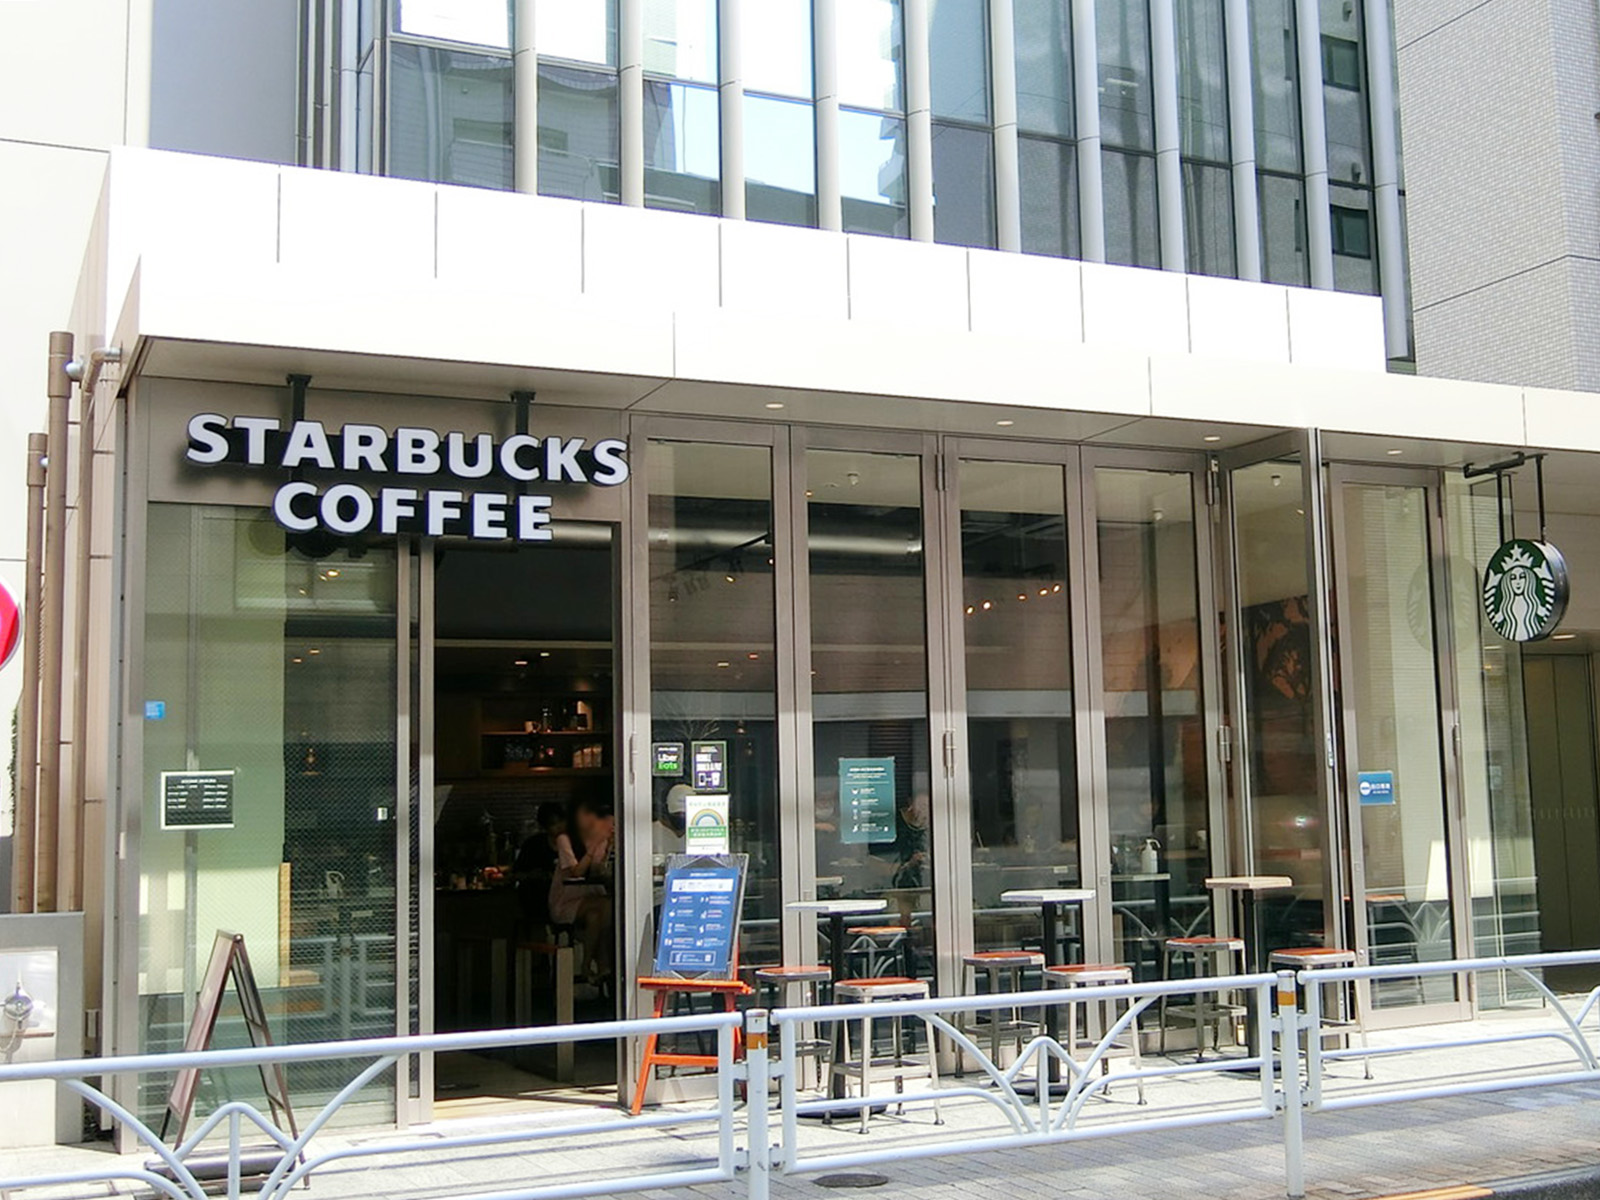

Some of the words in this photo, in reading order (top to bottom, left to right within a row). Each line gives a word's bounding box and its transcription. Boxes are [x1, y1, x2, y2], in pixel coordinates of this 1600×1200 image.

[186, 413, 629, 485] STARBUCKS
[273, 481, 554, 541] COFFEE
[657, 753, 678, 762] Uber
[657, 762, 678, 770] Eats
